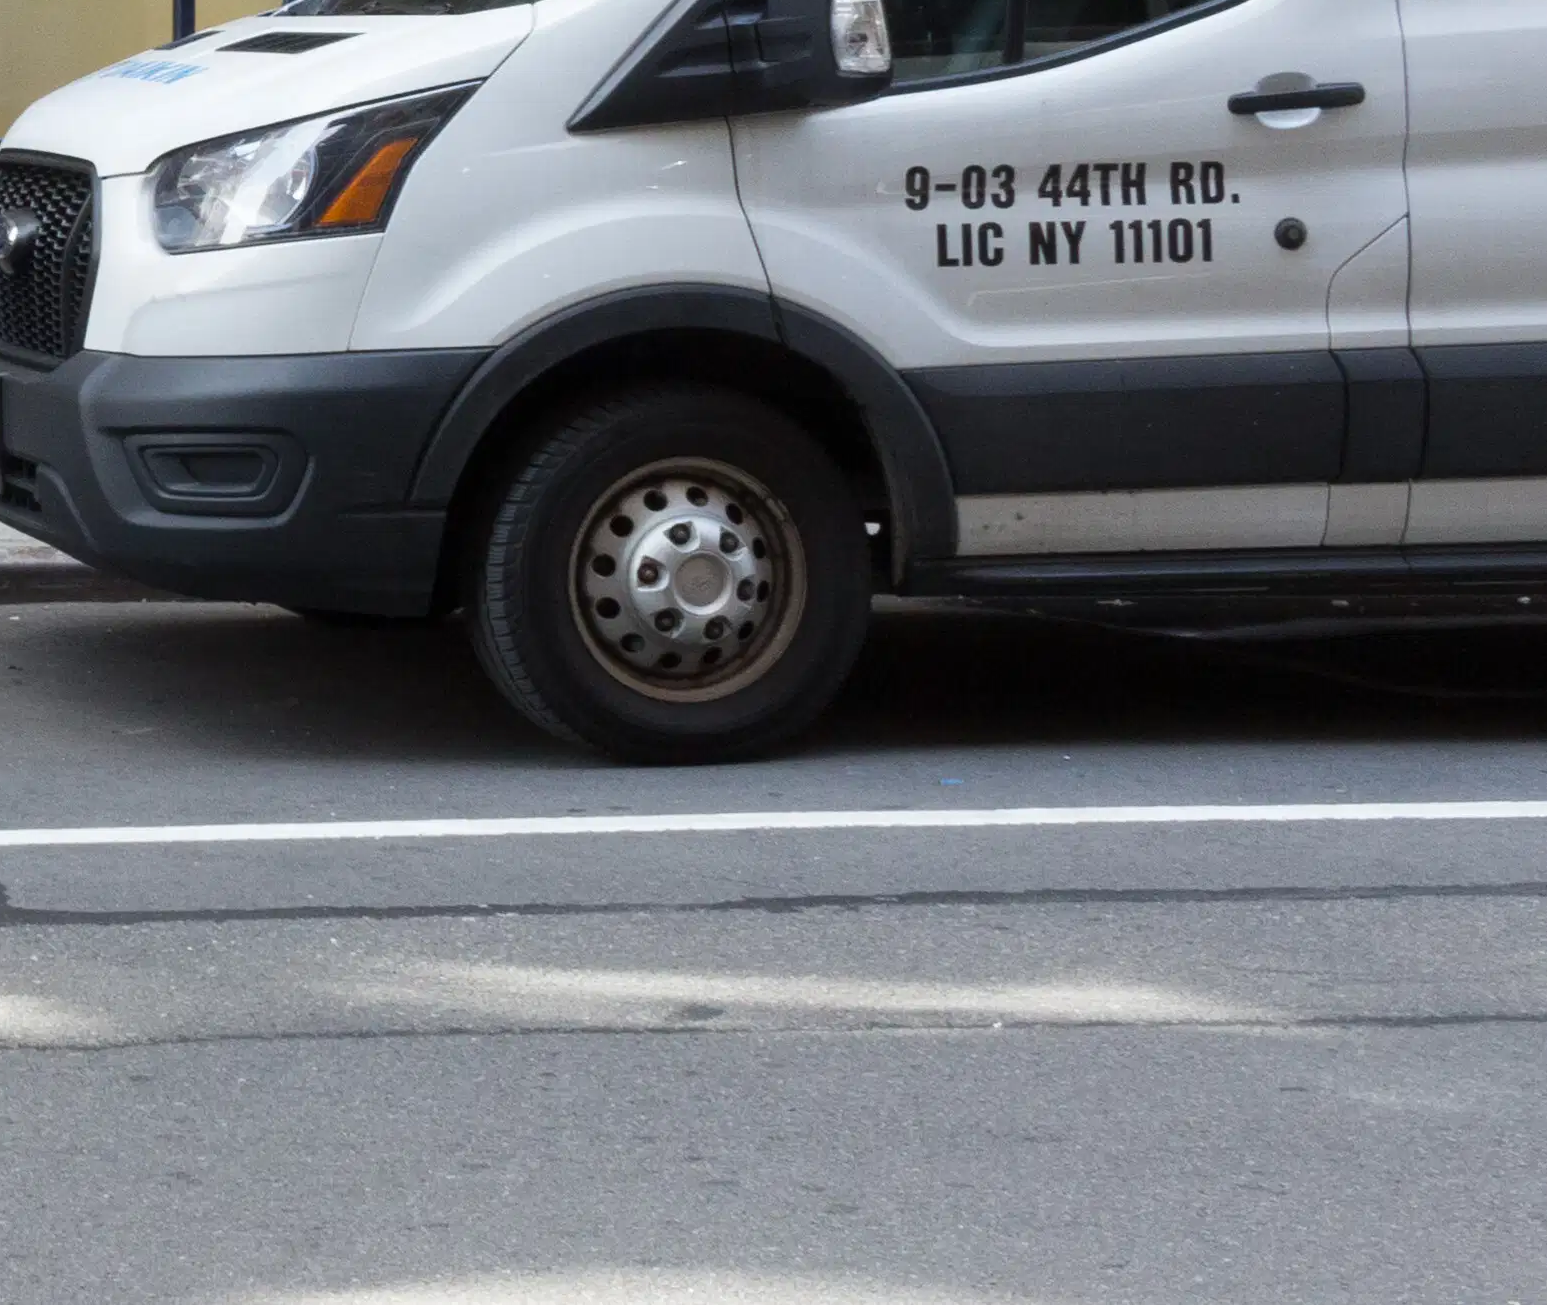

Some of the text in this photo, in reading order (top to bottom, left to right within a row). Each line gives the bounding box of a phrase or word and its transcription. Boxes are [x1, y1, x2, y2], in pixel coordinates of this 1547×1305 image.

[904, 160, 1241, 212] 9-03 44TH RD.
[936, 217, 1213, 268] LIC NY 11101
